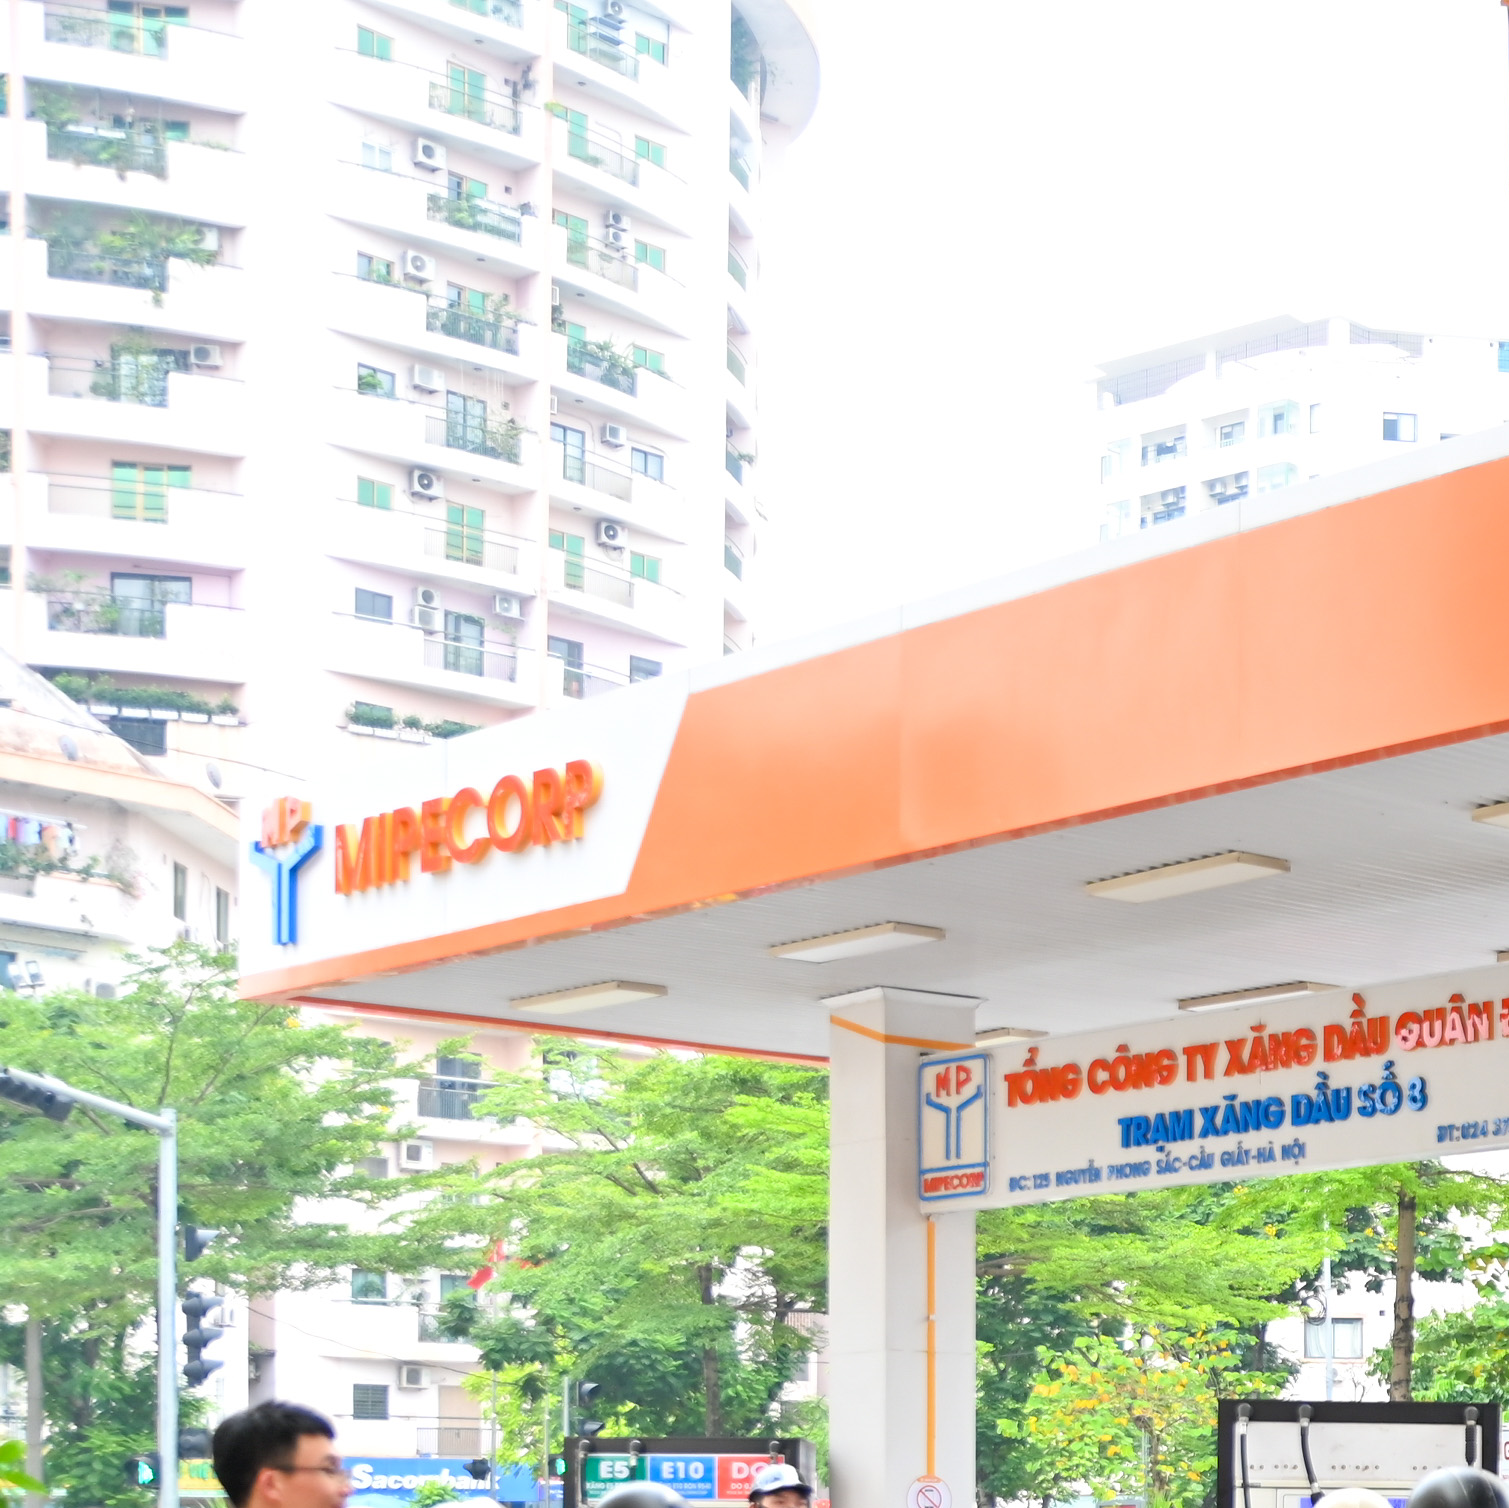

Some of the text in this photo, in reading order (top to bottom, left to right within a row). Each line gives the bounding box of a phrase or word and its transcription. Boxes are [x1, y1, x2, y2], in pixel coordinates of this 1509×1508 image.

[335, 759, 603, 895] MIPECORP
[1005, 1047, 1083, 1108] TỔNG
[1087, 1044, 1179, 1094] CÔNG
[1183, 1042, 1220, 1082] TY
[1224, 1024, 1317, 1077] XĂNG
[1323, 993, 1390, 1063] DẦU
[1395, 994, 1494, 1051] QUÂN
[936, 1065, 972, 1097] MP
[1118, 1060, 1428, 1153] TRẠM XĂNG DẦU SỐ 8
[1107, 1161, 1150, 1181] PHONG
[1282, 1138, 1307, 1165] NỘI
[924, 1171, 985, 1194] MIPECORP
[599, 1461, 630, 1478] E5
[662, 1461, 704, 1478] E10
